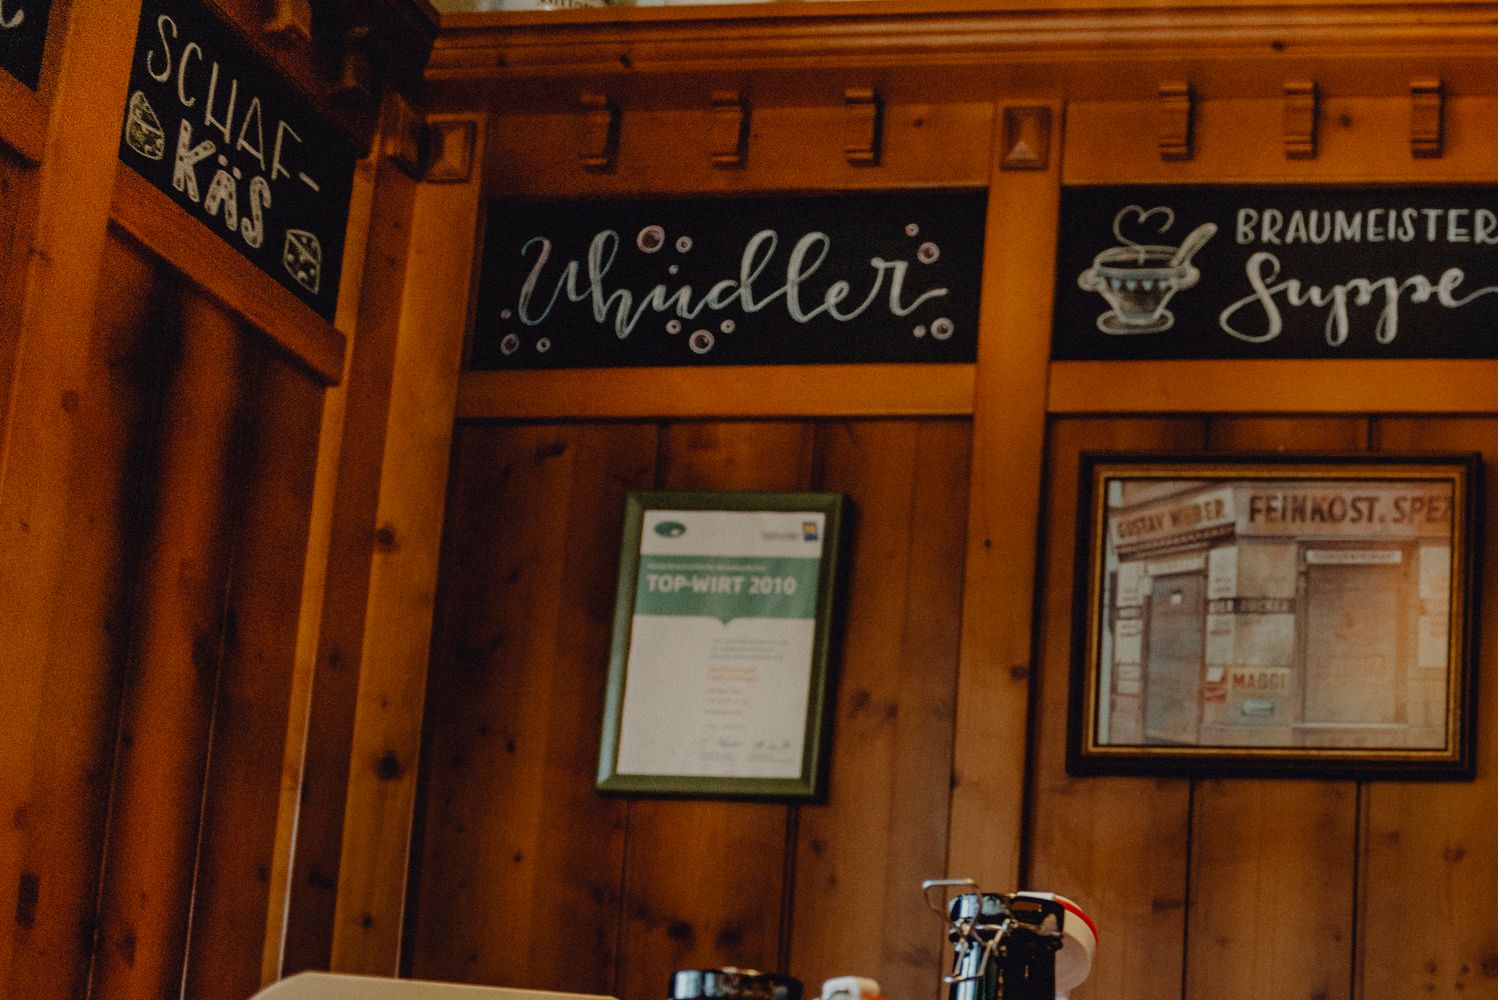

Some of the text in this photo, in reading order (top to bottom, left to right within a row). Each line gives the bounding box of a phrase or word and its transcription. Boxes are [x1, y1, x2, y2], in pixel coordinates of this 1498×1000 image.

[147, 15, 320, 192] SCHAF-
[172, 118, 272, 249] KÄS
[647, 573, 798, 596] TOP-WIRT 2010
